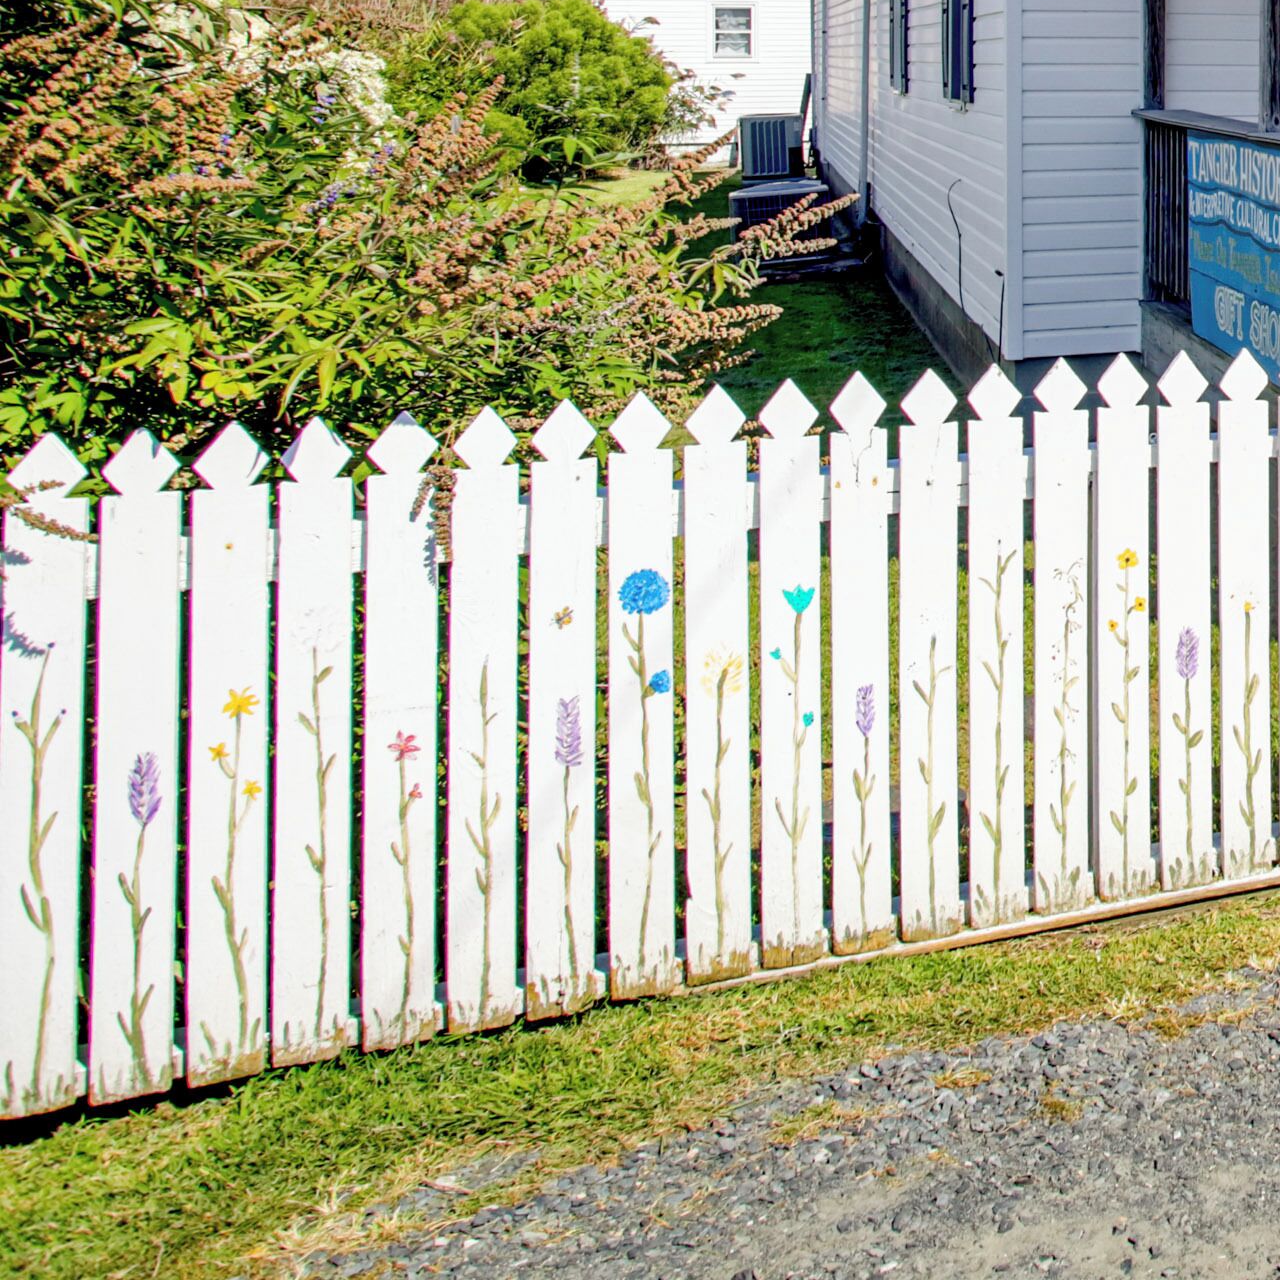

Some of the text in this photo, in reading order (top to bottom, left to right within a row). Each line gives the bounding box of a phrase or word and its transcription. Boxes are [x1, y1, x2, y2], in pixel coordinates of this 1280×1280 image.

[1188, 140, 1237, 188] TANGIER
[1236, 199, 1273, 243] CULTURAL
[1214, 285, 1245, 341] GIFT
